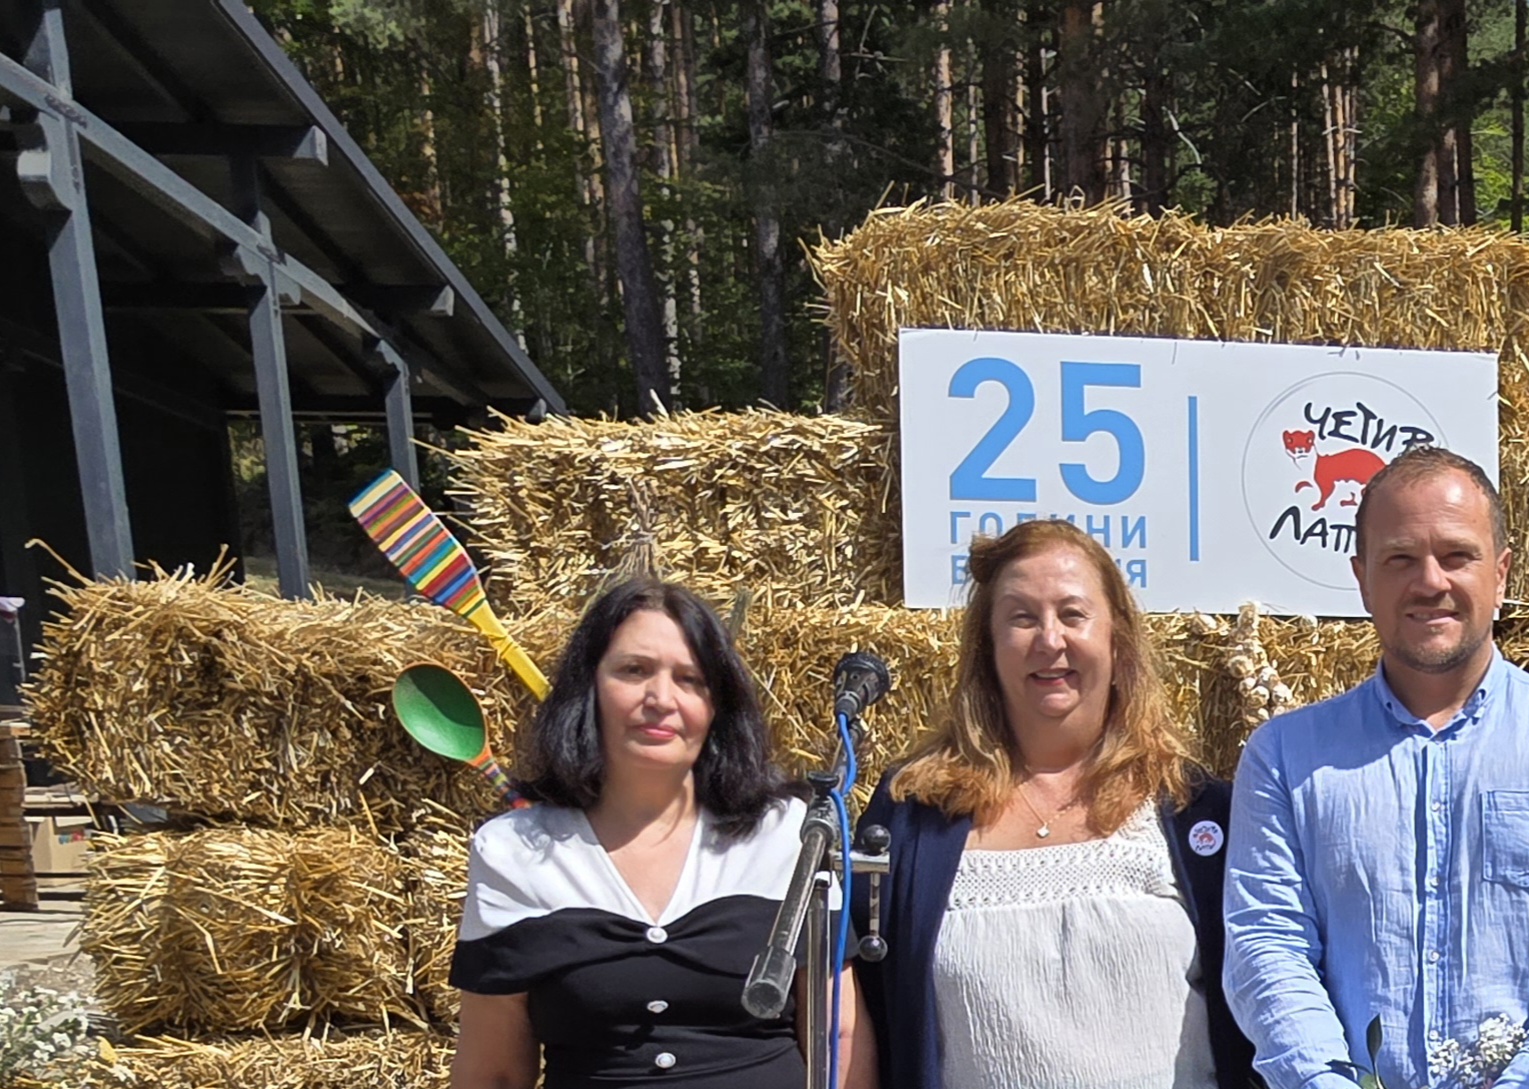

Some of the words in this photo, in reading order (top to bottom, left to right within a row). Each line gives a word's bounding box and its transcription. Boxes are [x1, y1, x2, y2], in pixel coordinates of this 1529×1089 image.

[948, 357, 1146, 506] 25
[1304, 402, 1436, 452] ЧЕТИР
[949, 510, 1147, 549] ГОНИ
[1269, 506, 1357, 554] ЛАП
